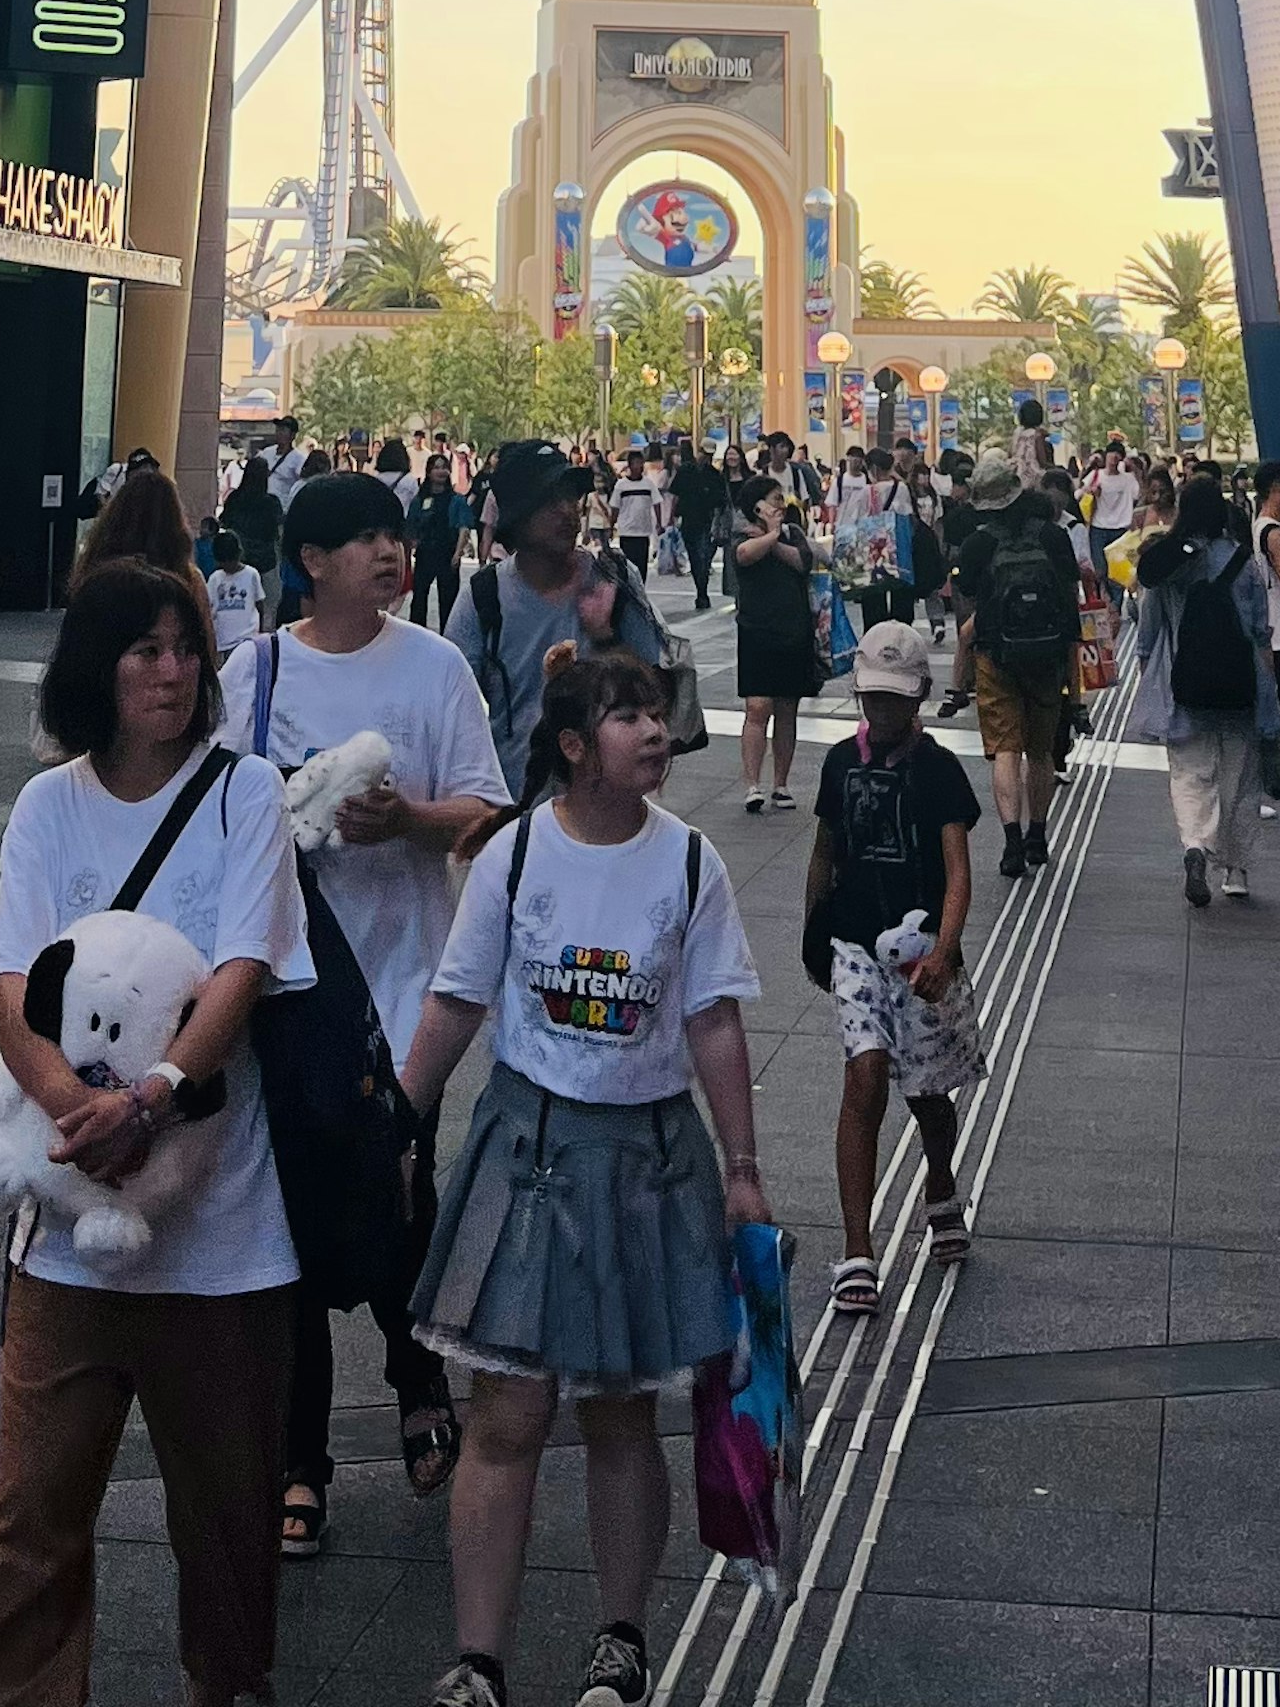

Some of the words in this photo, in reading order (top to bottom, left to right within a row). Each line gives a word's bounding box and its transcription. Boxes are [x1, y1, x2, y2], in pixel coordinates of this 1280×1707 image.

[634, 52, 703, 76] UNIVERSAL
[705, 56, 752, 77] STUDIOS
[53, 172, 125, 250] SHACK
[560, 945, 631, 973] SUPER
[523, 960, 665, 1007] NINTENDO
